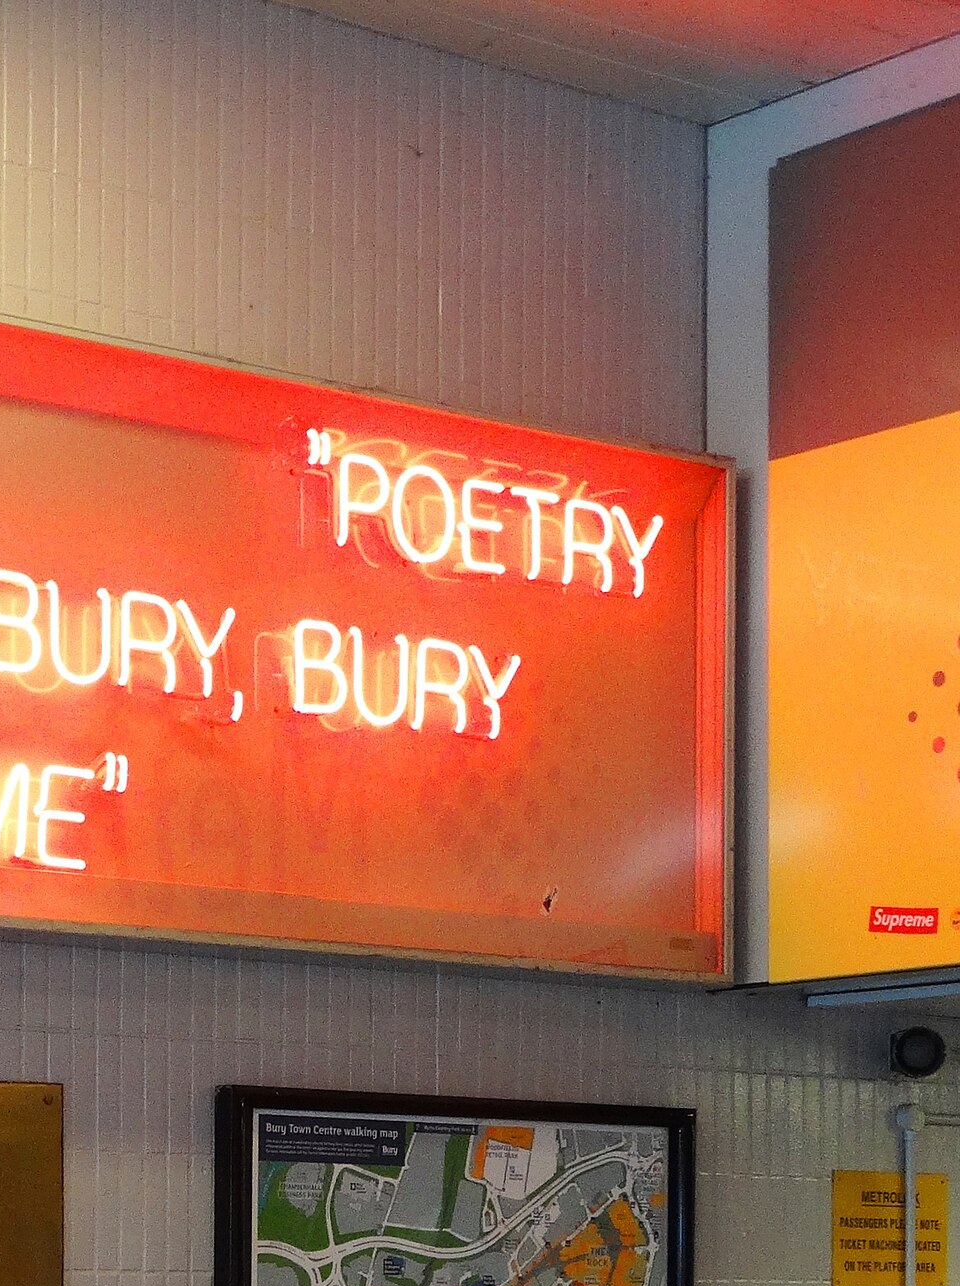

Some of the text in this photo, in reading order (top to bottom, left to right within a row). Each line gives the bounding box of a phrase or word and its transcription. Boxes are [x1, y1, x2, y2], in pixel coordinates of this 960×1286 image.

[291, 618, 522, 740] BURY
[872, 908, 935, 932] Supreme
[265, 1122, 399, 1140] Bury Town Centre walking map
[381, 1145, 399, 1156] Bury
[861, 1190, 921, 1204] METROLK
[839, 1216, 888, 1229] PASSENGERS
[839, 1239, 867, 1250] TICKET
[844, 1260, 936, 1273] ON THE PLATFO AREA
